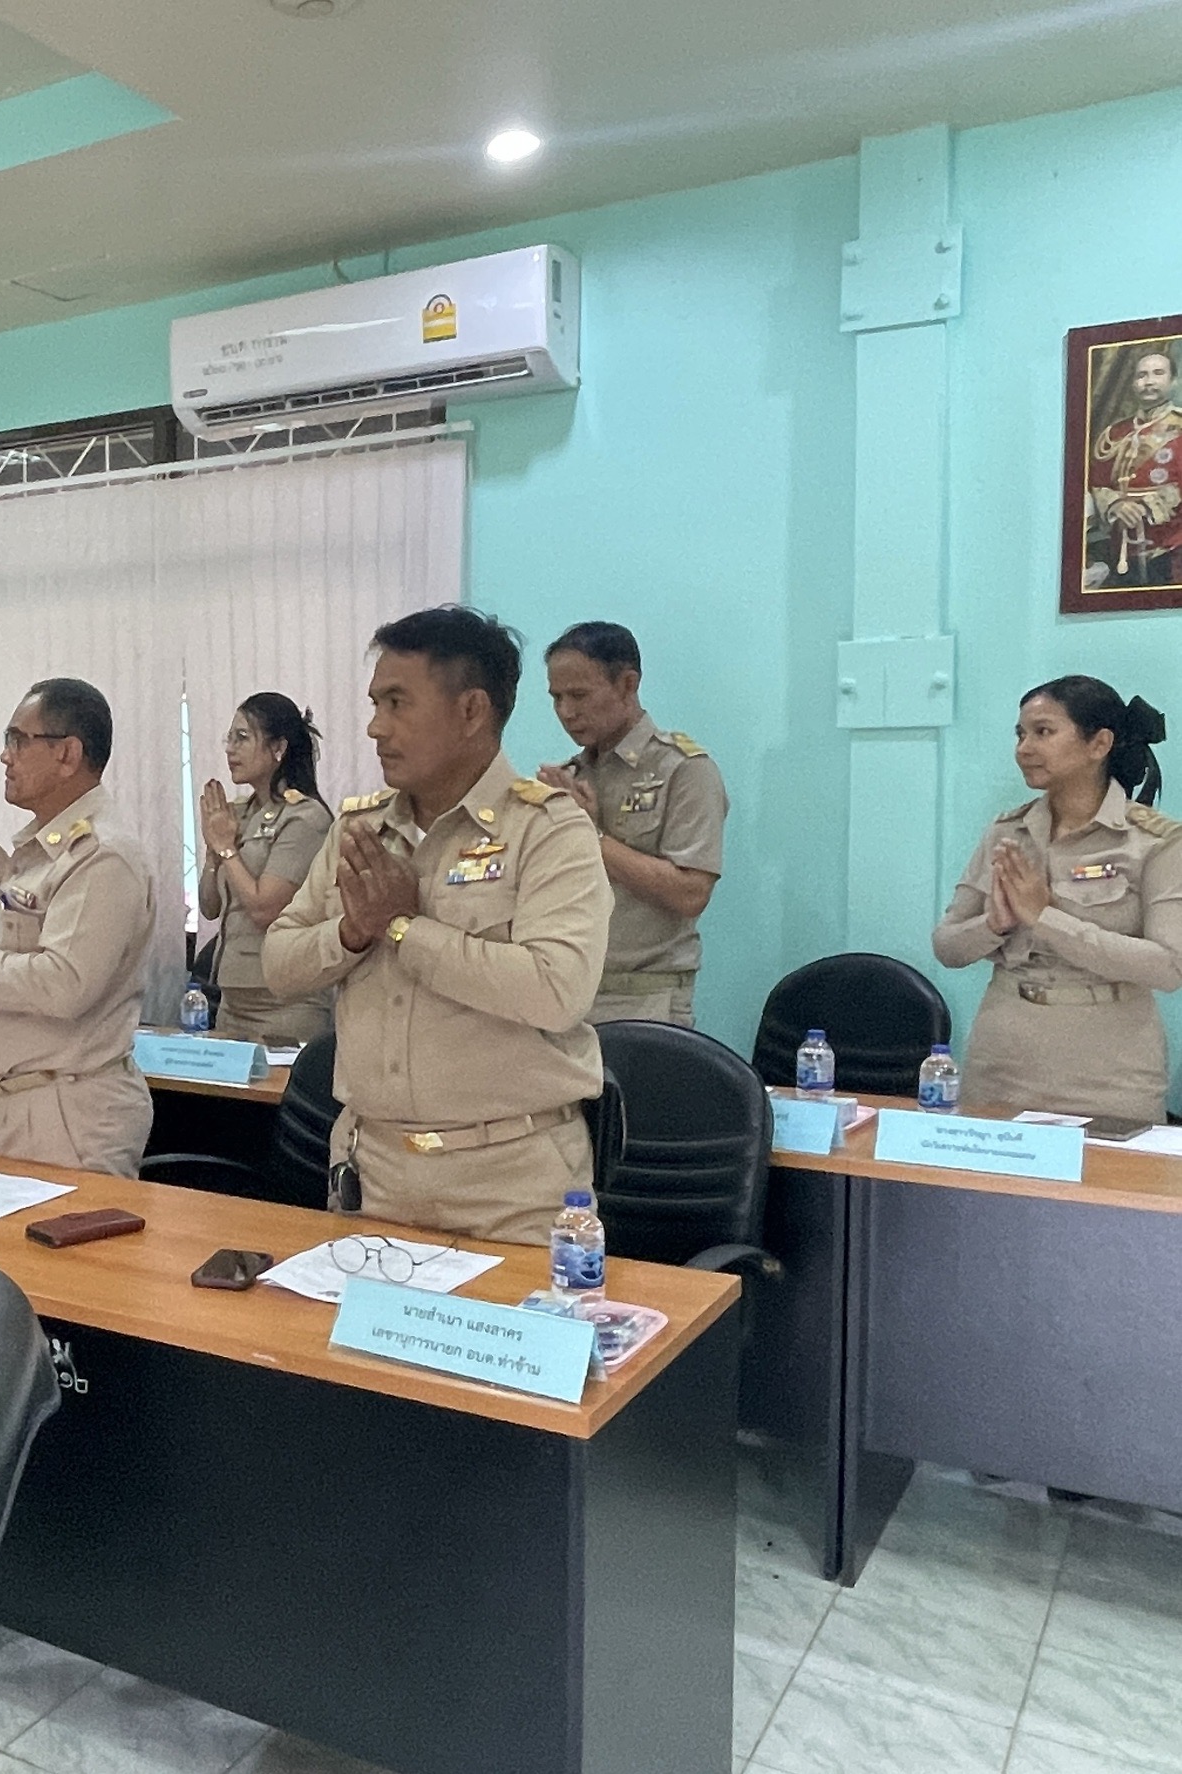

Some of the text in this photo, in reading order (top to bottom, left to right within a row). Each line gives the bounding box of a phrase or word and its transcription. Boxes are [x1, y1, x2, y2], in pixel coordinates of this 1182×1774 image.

[371, 1326, 541, 1376] เลขานุการนายก อบต.ท่าข้าม
